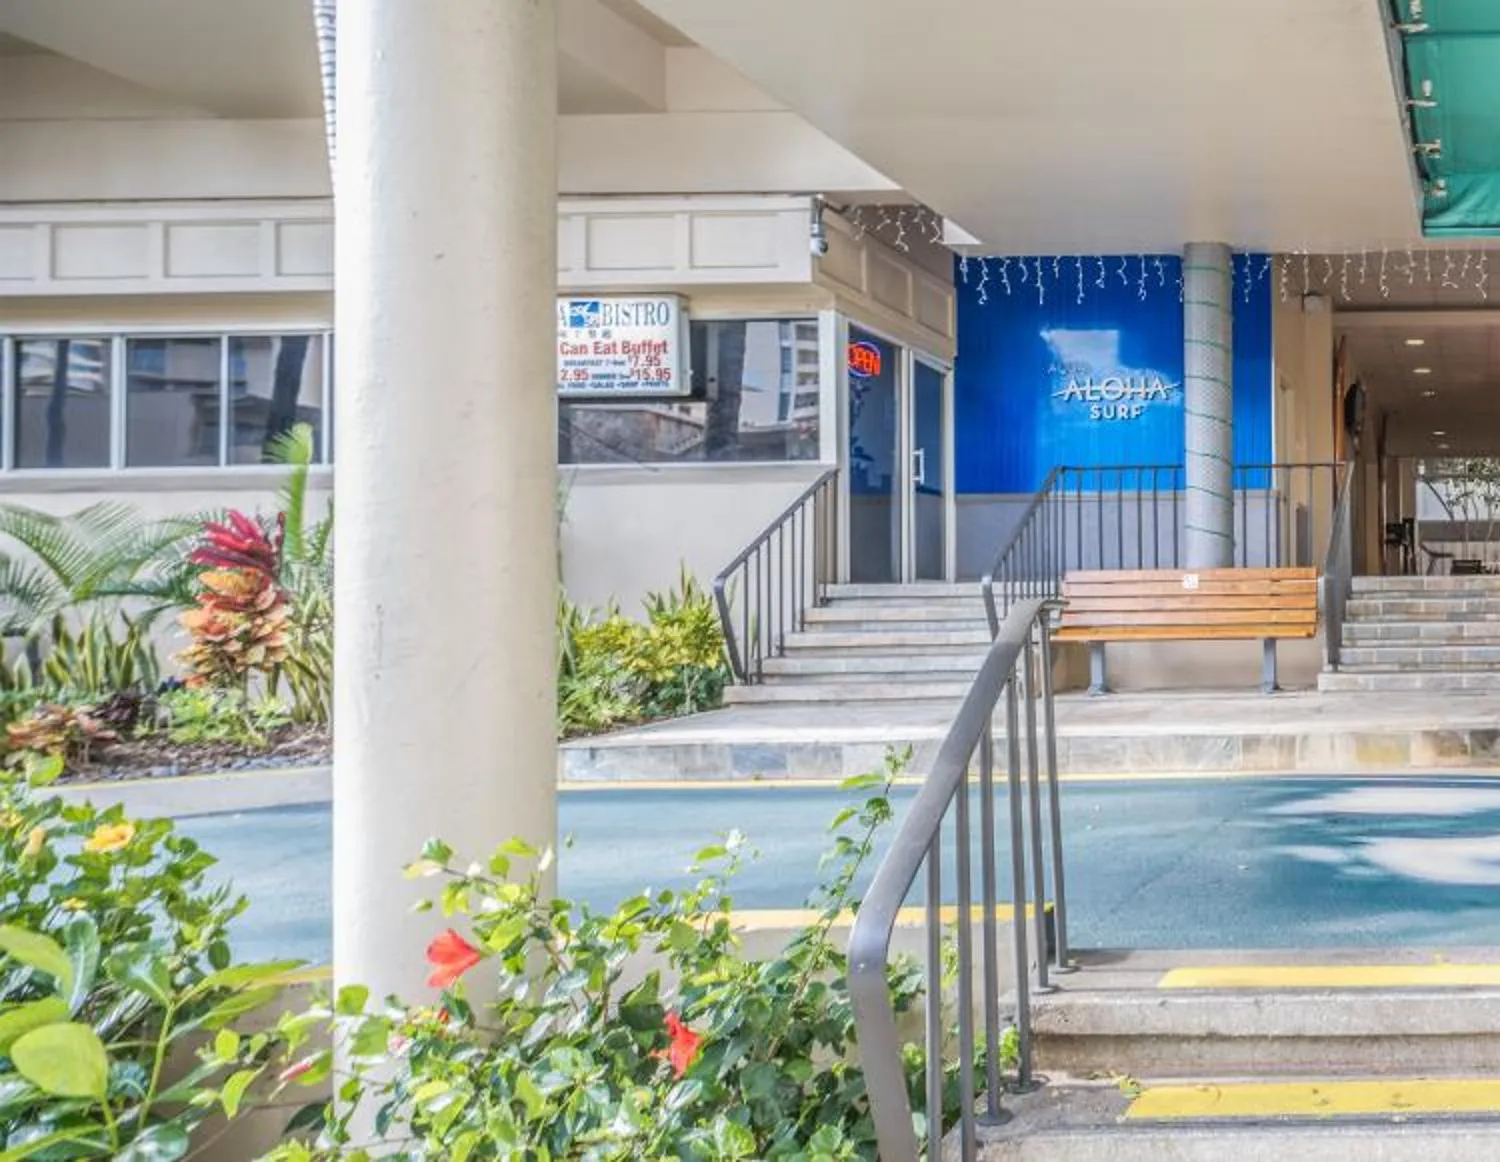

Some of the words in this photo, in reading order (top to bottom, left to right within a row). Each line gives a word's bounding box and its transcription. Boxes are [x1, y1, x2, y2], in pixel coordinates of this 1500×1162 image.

[602, 302, 670, 326] BISTRO
[560, 341, 589, 355] Can
[593, 341, 617, 355] Eat
[621, 339, 668, 356] Buffet
[1063, 376, 1168, 401] ALOHA
[1089, 403, 1144, 420] SURF
